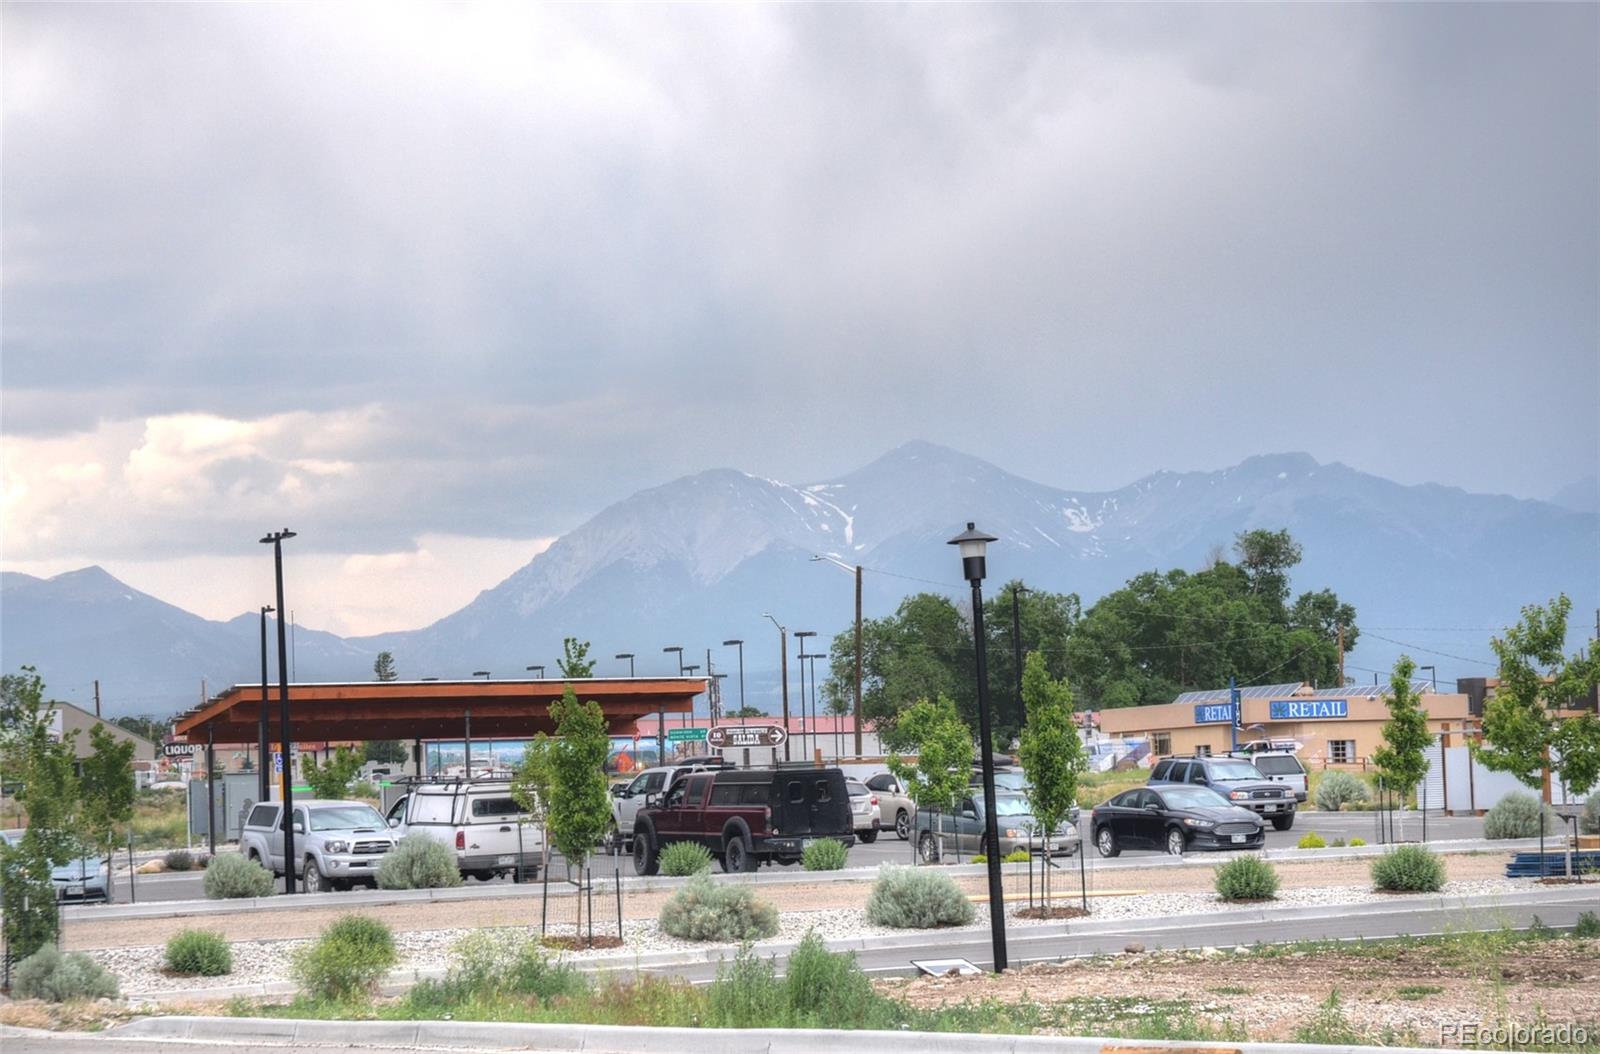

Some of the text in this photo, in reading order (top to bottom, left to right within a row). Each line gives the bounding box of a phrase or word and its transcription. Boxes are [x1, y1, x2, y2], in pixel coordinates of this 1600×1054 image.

[1204, 705, 1232, 721] RETAI
[1288, 701, 1347, 718] RETAIL
[732, 734, 761, 745] SALIDA
